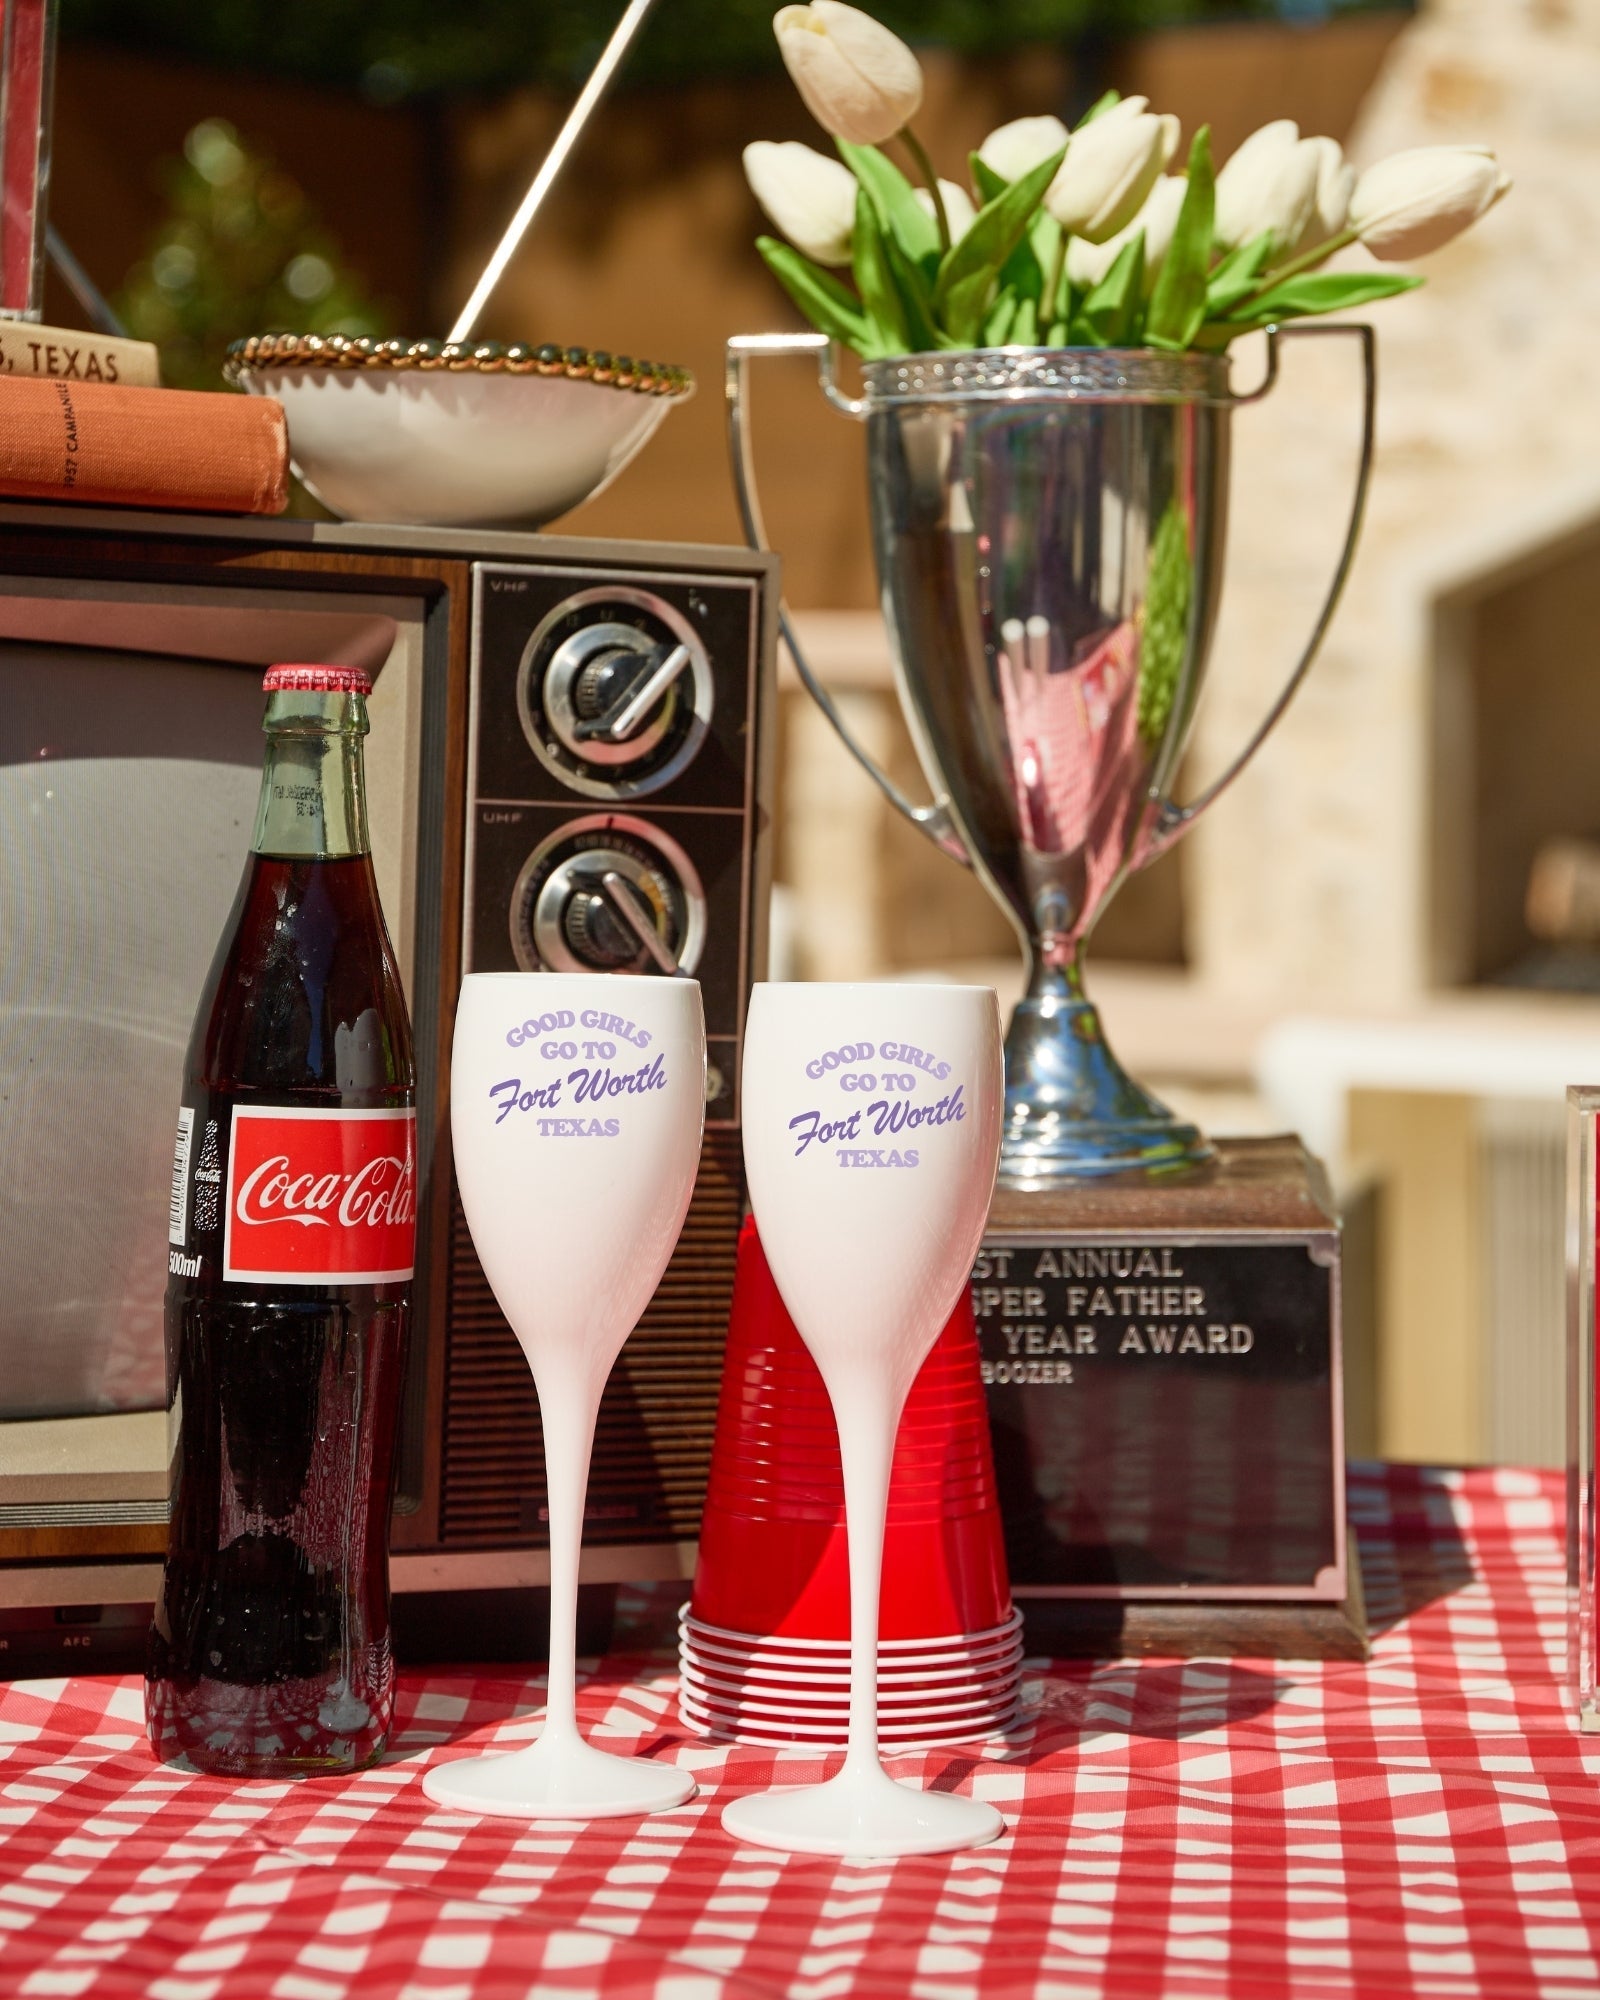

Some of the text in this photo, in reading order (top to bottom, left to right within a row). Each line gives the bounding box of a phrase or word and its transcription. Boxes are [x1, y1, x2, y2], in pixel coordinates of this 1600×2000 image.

[27, 343, 119, 382] TEXAS
[56, 383, 78, 488] 1957 CAMPANILE
[490, 581, 529, 592] VHF
[483, 813, 523, 823] UHF
[506, 1010, 652, 1048] GOOD GIRLS
[540, 1041, 617, 1060] GO TO
[806, 1041, 951, 1080] GOOD GIRLS
[489, 1053, 667, 1125] Fort Worth
[840, 1073, 916, 1092] GO TO
[536, 1118, 620, 1137] TEXAS
[789, 1085, 967, 1157] Fort Worth
[836, 1149, 919, 1168] TEXAS
[236, 1155, 414, 1227] Coca-Cola
[1034, 1249, 1184, 1278] ANNUAL
[1066, 1286, 1207, 1316] FATHER
[1001, 1324, 1098, 1354] YEAR
[1118, 1324, 1255, 1354] AWARD
[980, 1360, 1074, 1384] BOOZER
[63, 1636, 91, 1648] AFC
